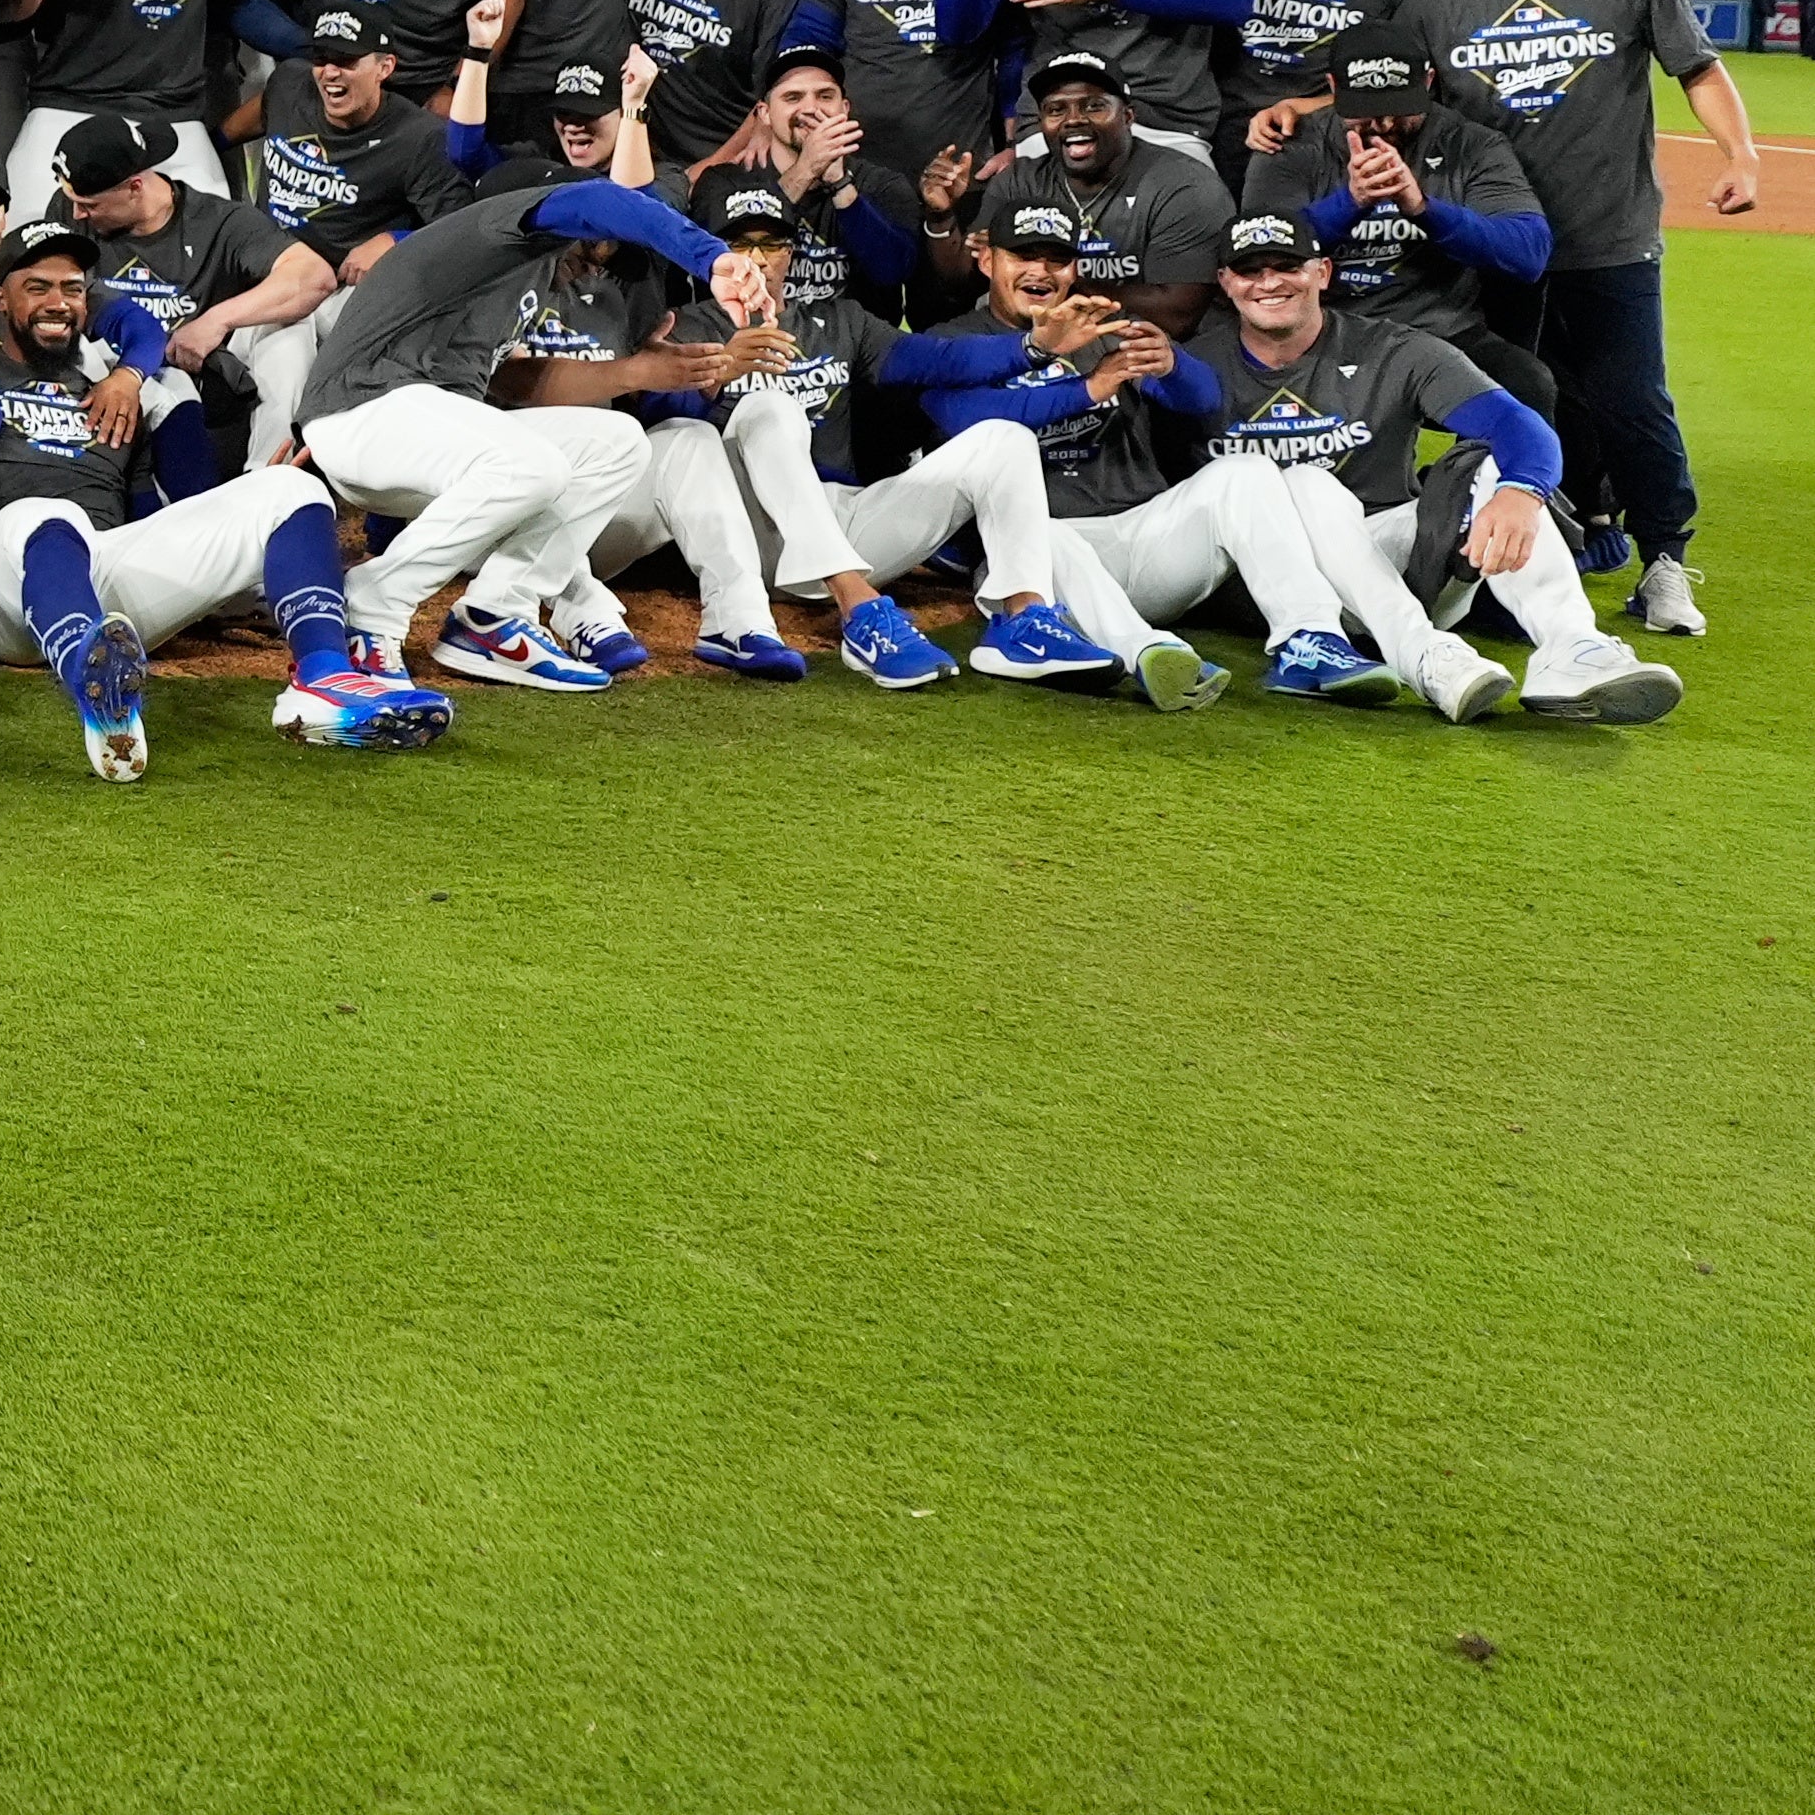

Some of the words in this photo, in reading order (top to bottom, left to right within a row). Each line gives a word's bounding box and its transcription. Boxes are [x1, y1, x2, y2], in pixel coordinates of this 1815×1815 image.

[908, 31, 937, 42] 202
[1243, 18, 1319, 46] Dodgers
[1450, 32, 1616, 70] CHAMPIONS
[1496, 60, 1574, 96] Dodgers
[1350, 221, 1427, 241] MPION
[1077, 255, 1139, 279] PIONS
